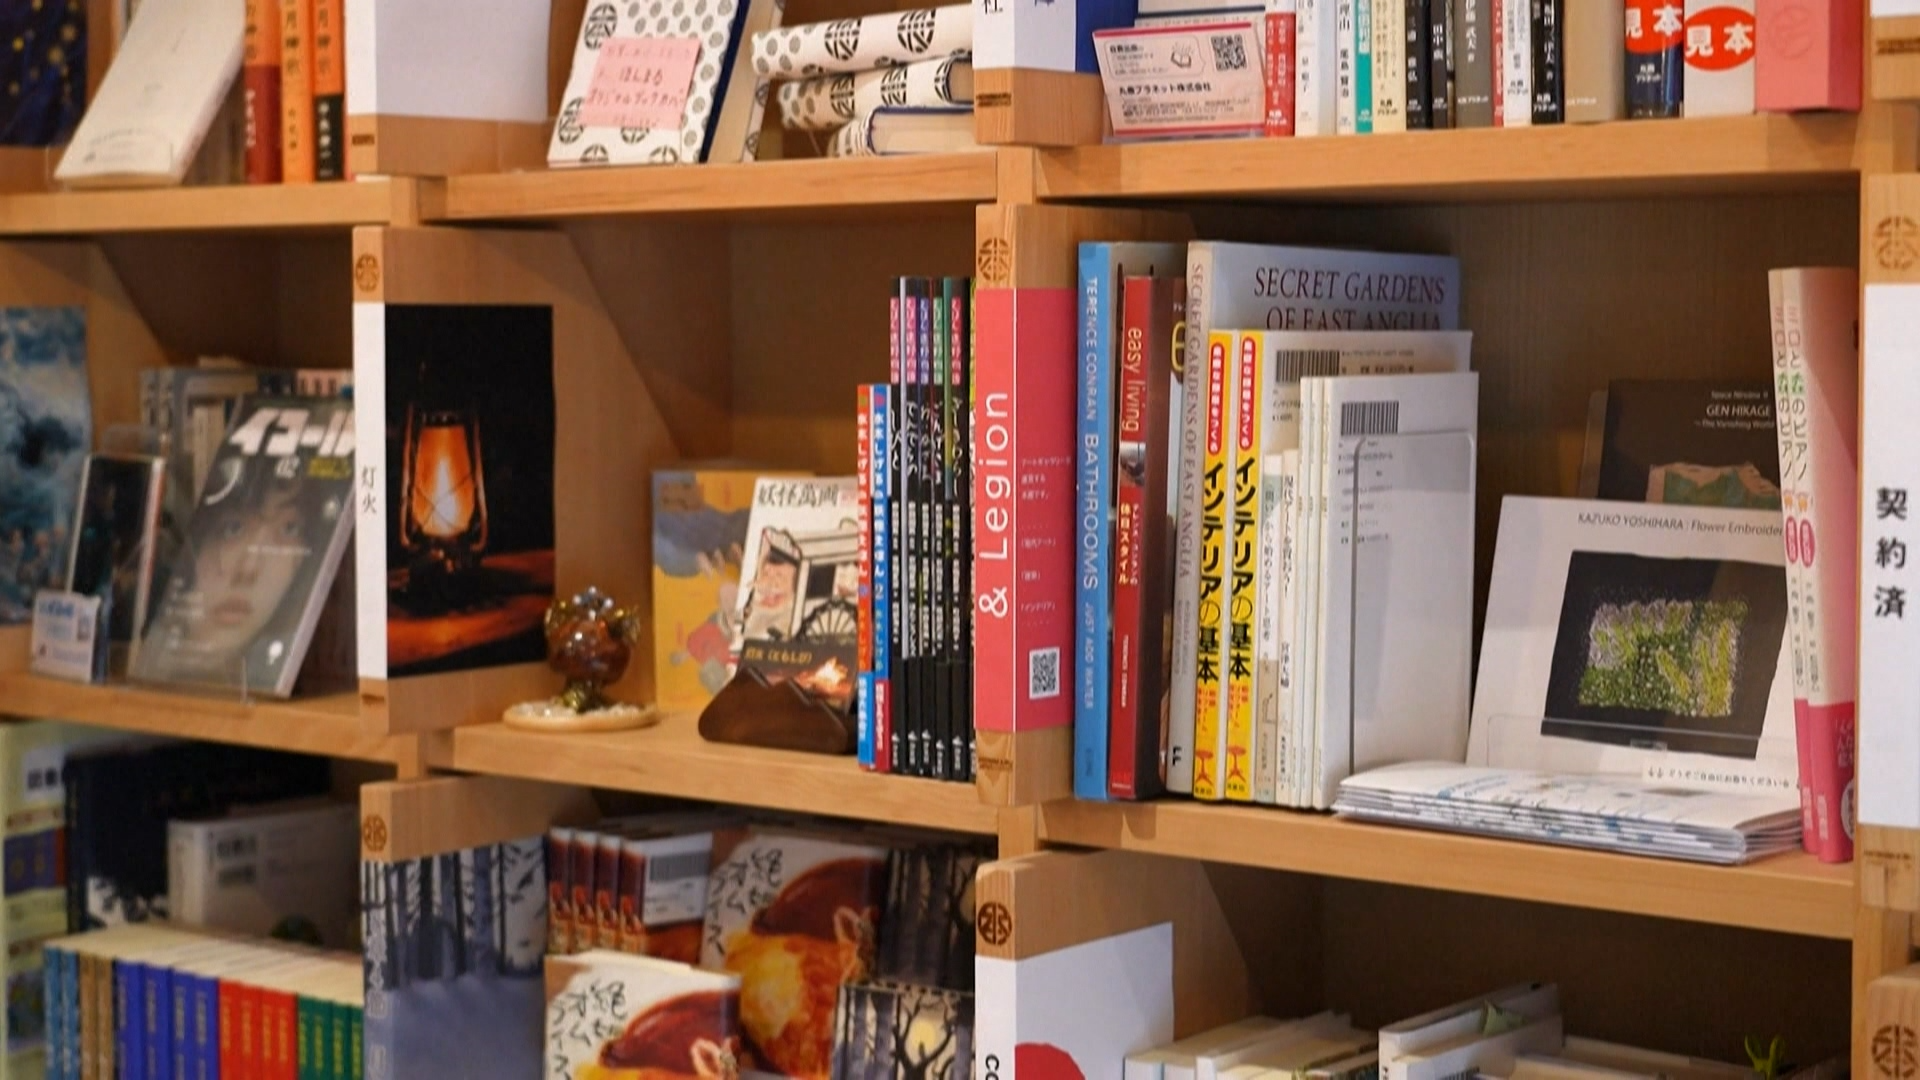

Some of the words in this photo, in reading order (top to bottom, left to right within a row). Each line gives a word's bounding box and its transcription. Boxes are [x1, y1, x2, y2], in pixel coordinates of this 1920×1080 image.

[1625, 5, 1683, 39] 見本
[1686, 22, 1754, 58] 見本
[1190, 262, 1204, 333] SECRET
[1254, 266, 1340, 299] SECRET
[1344, 271, 1445, 304] GARDENS
[1085, 277, 1098, 348] TERENCE
[1266, 306, 1296, 330] OF
[1303, 307, 1357, 330] EAST
[1363, 310, 1442, 330] ANGLIA
[1125, 327, 1143, 374] easy
[1085, 354, 1098, 421] CONRAN
[1184, 337, 1201, 422] GARDENS
[1121, 379, 1147, 432] living
[1707, 404, 1730, 416] GEN
[1732, 405, 1771, 418] HIKAGE
[362, 465, 377, 514] 灯火
[978, 392, 1011, 562] Legion
[1182, 456, 1196, 502] EAST
[1083, 433, 1099, 590] BATHROOMS
[1578, 512, 1621, 527] KAZUKO
[1624, 515, 1684, 530] YOSHIHARA
[1691, 519, 1726, 533] Flower
[1178, 507, 1194, 578] ANGLIA
[1874, 486, 1907, 620] 契約済
[1199, 462, 1225, 684] インテリアの基本
[1230, 457, 1256, 680] インテリアの基本
[978, 586, 1009, 619] &
[1083, 667, 1094, 709] WATER
